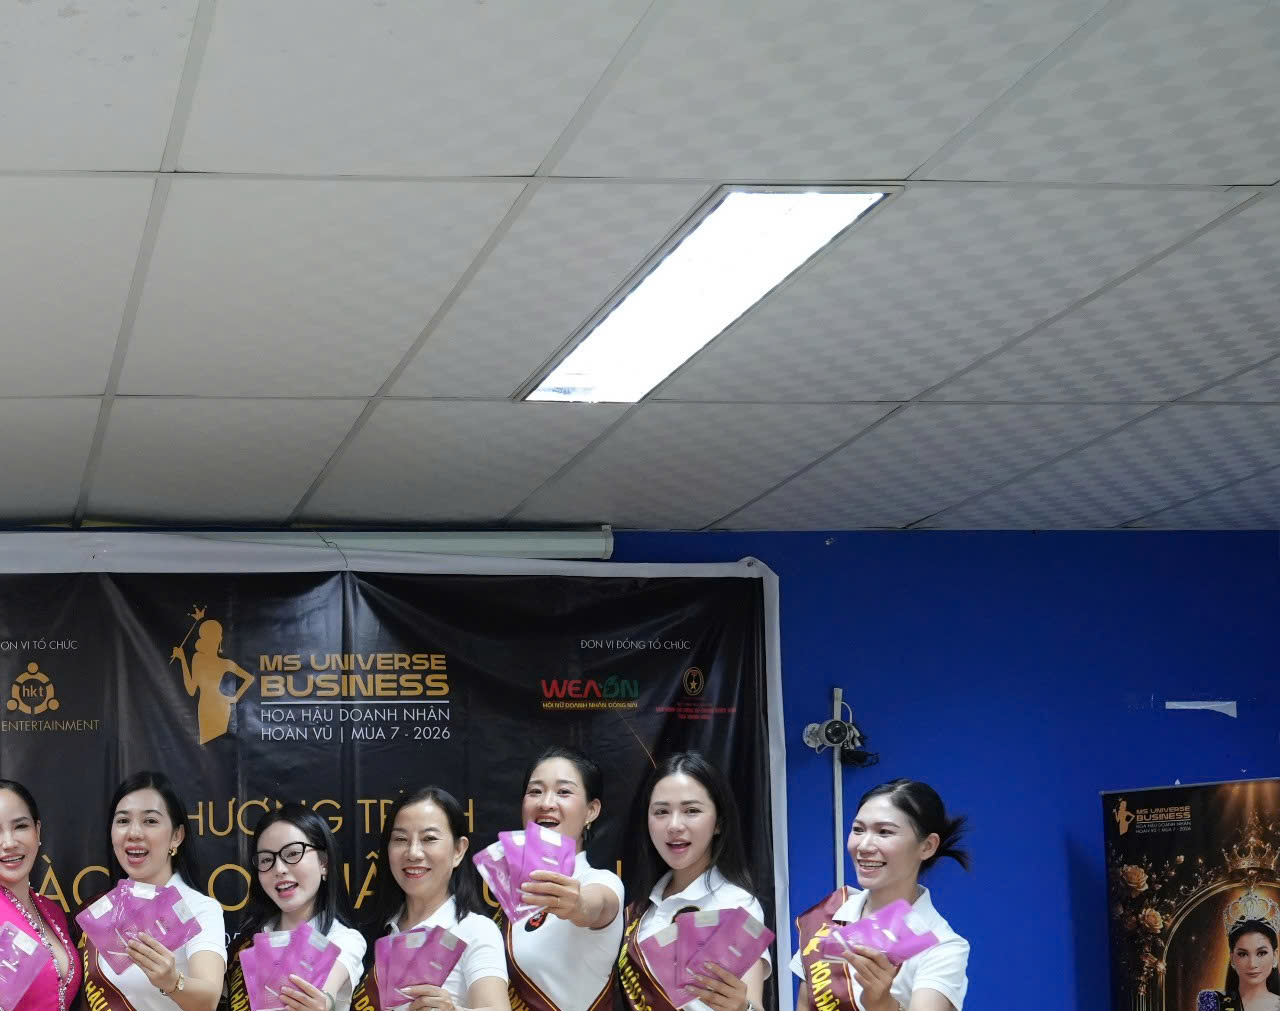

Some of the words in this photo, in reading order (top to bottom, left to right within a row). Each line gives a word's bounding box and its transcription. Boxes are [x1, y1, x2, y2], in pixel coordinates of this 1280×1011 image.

[259, 654, 302, 671] MS
[310, 653, 447, 671] UNIVERSE
[22, 685, 44, 697] hkt
[260, 673, 450, 697] BUSINESS
[261, 709, 296, 723] HOA
[301, 706, 334, 726] HẬU
[339, 708, 398, 722] DOANH
[404, 706, 450, 722] NHÂN
[1, 719, 100, 732] ENTERTAINMENT
[261, 724, 308, 741] HOÀN
[314, 725, 333, 741] VŨ
[351, 724, 386, 740] MÙA
[390, 726, 401, 740] 7
[413, 726, 451, 740] 2026
[1136, 812, 1191, 822] BUSINESS
[810, 959, 832, 996] HOA
